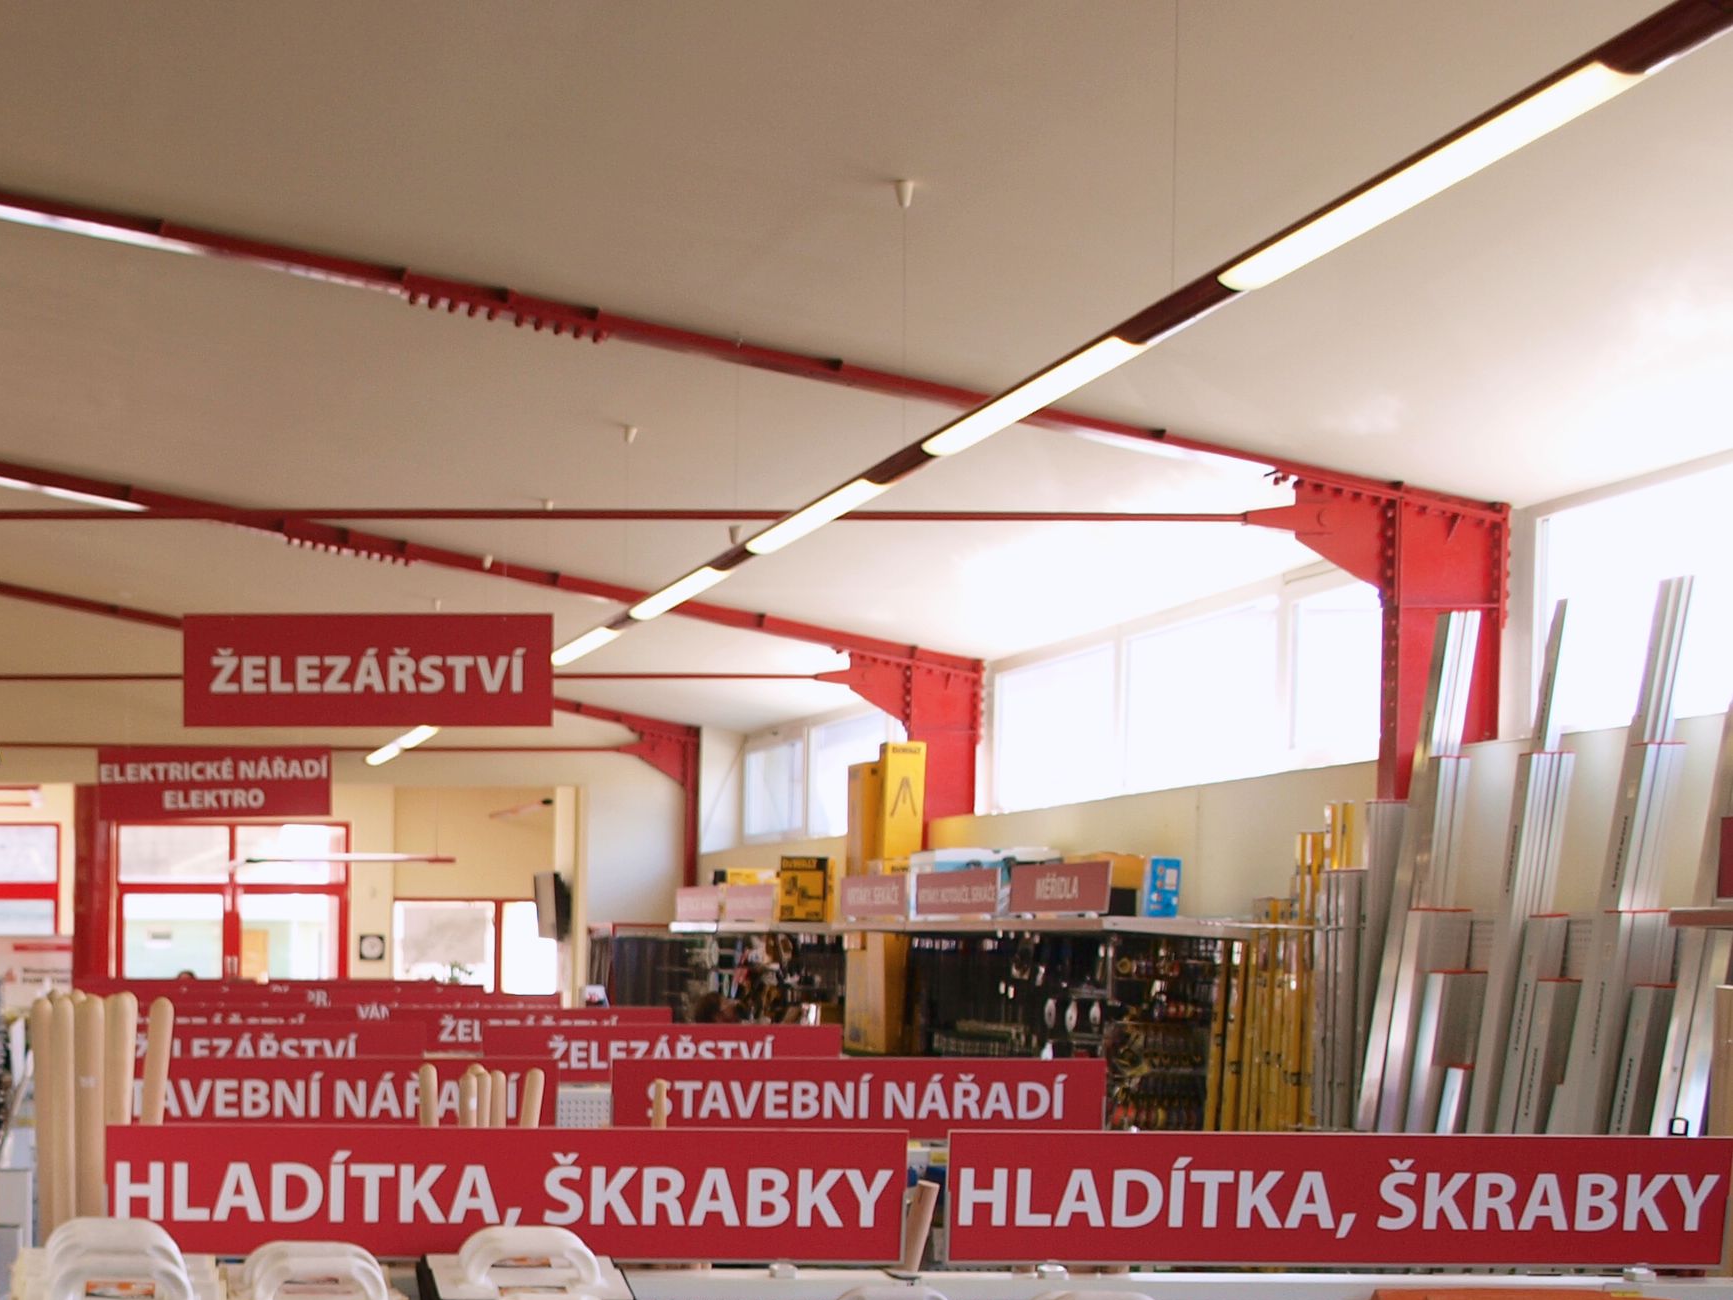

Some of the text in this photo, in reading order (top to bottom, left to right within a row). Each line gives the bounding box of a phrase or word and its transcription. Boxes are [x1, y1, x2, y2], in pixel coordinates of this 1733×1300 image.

[210, 647, 526, 694] ŽELEZÁŘSTVÍ
[100, 755, 328, 783] ELEKTRICKÉ NÁŘADÍ
[163, 788, 265, 810] ELEKTRO
[646, 1073, 1069, 1121] STAVEBNÍ NÁŘADÍ
[114, 1150, 895, 1229] HLADÍTKA, ŠKRABKY
[957, 1156, 1720, 1239] HLADÍTKA, ŠKRABKY
